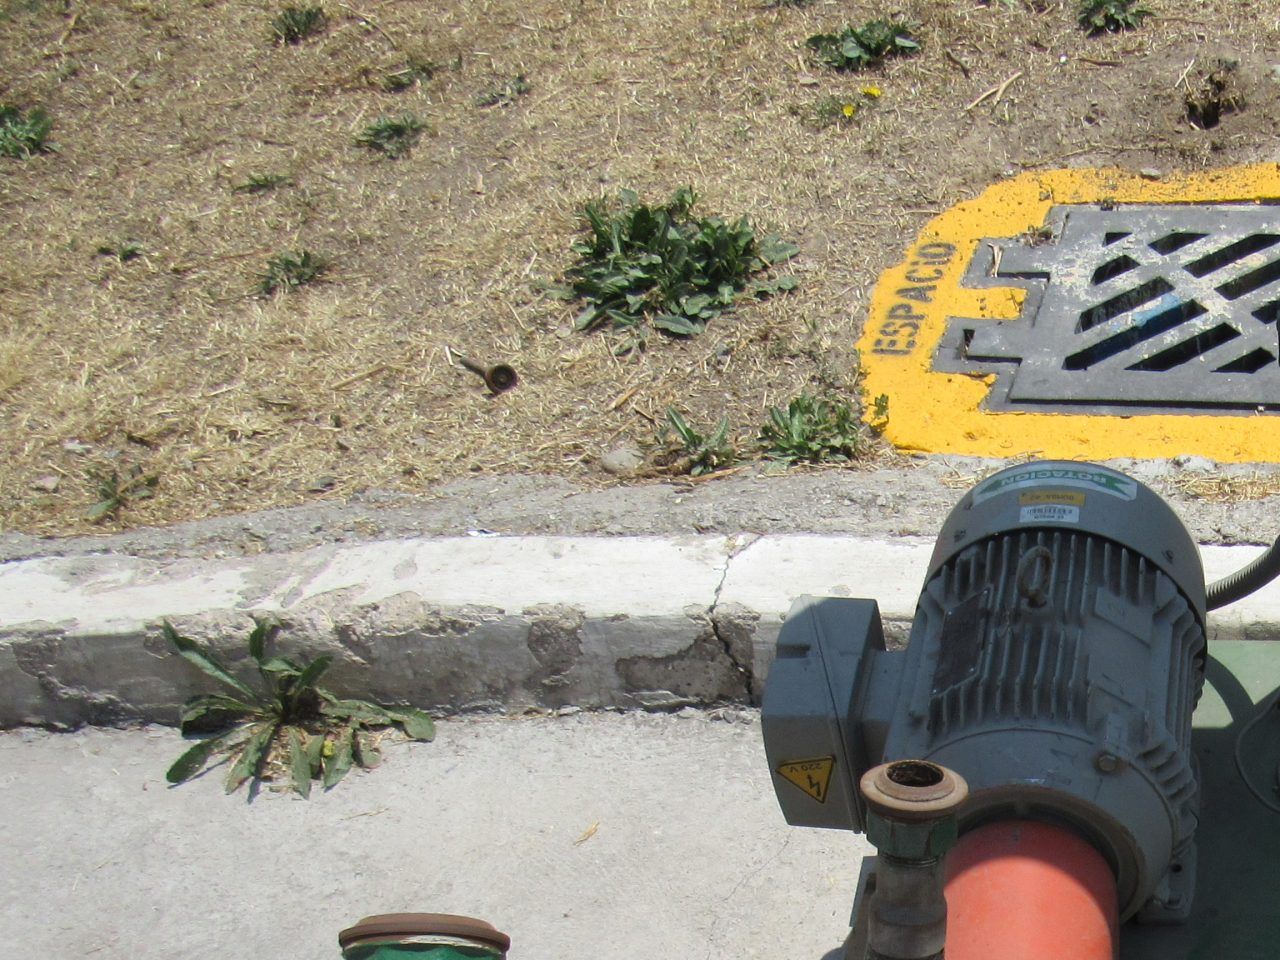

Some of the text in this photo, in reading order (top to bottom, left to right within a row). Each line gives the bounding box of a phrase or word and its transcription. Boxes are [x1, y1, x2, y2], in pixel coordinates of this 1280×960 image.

[872, 242, 956, 355] ESPACIO
[1001, 471, 1107, 487] ROTACION
[801, 763, 823, 771] 220
